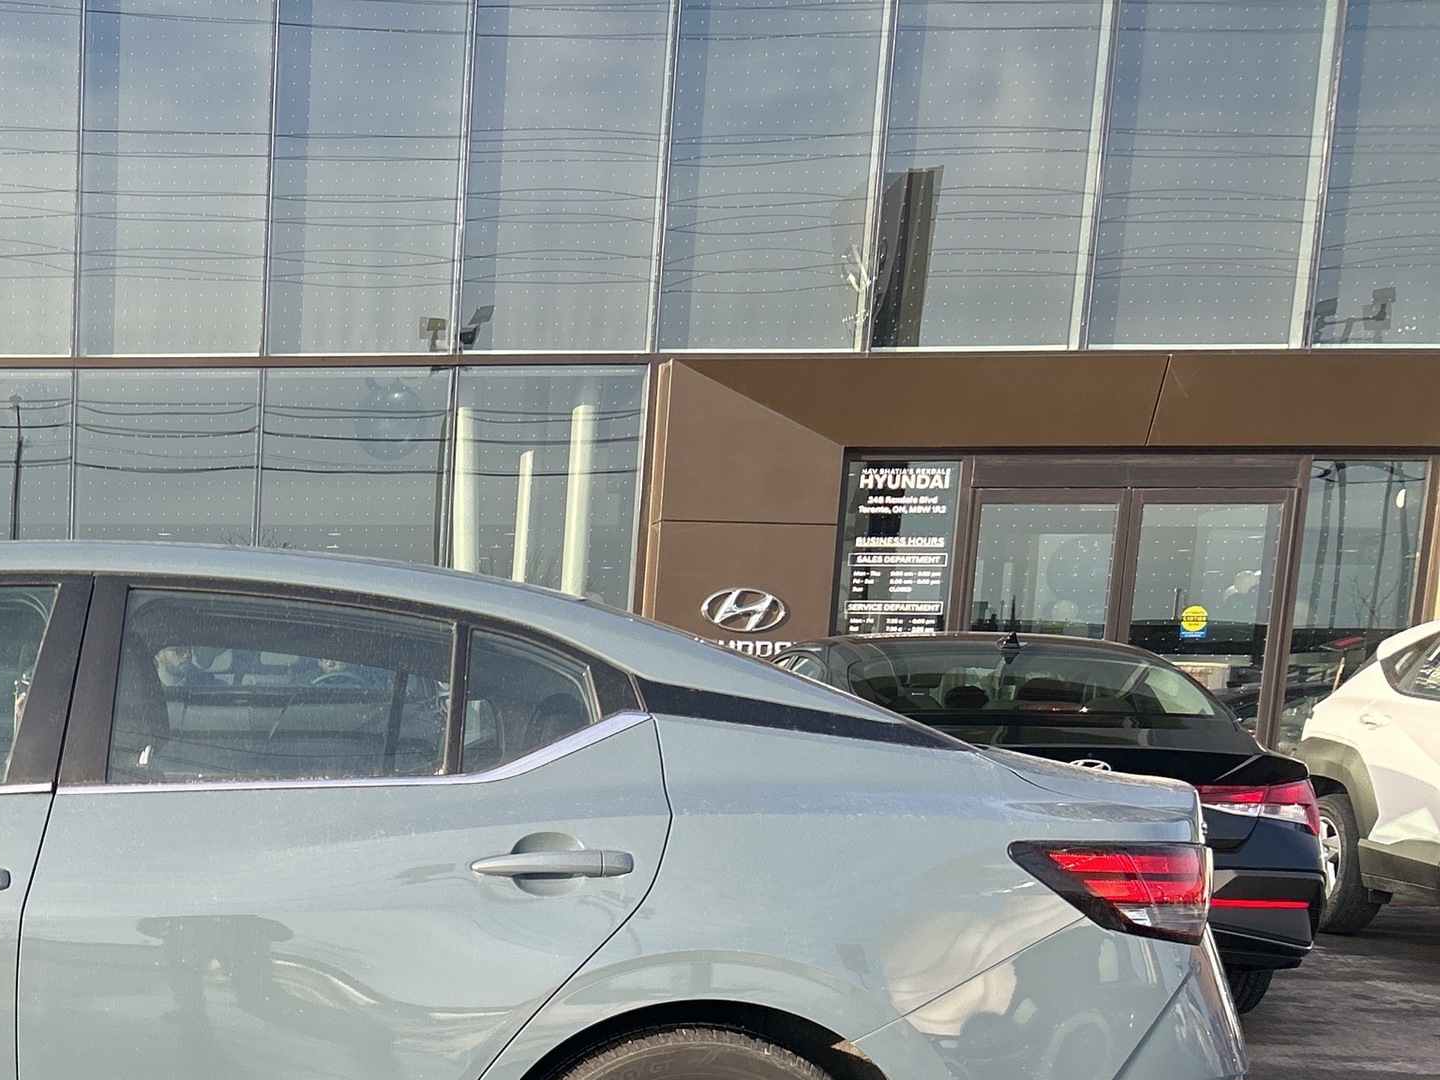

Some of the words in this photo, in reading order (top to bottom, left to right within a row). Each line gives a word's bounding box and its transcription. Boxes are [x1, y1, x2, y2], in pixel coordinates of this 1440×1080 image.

[859, 474, 951, 489] HYUNDAI
[885, 496, 918, 504] Rexdale
[919, 496, 938, 504] Blvd
[858, 506, 891, 514] Toronto,
[892, 506, 908, 514] ON,
[855, 537, 907, 547] BUSINESS
[907, 537, 945, 547] HOURS
[847, 603, 883, 611] SERVICE
